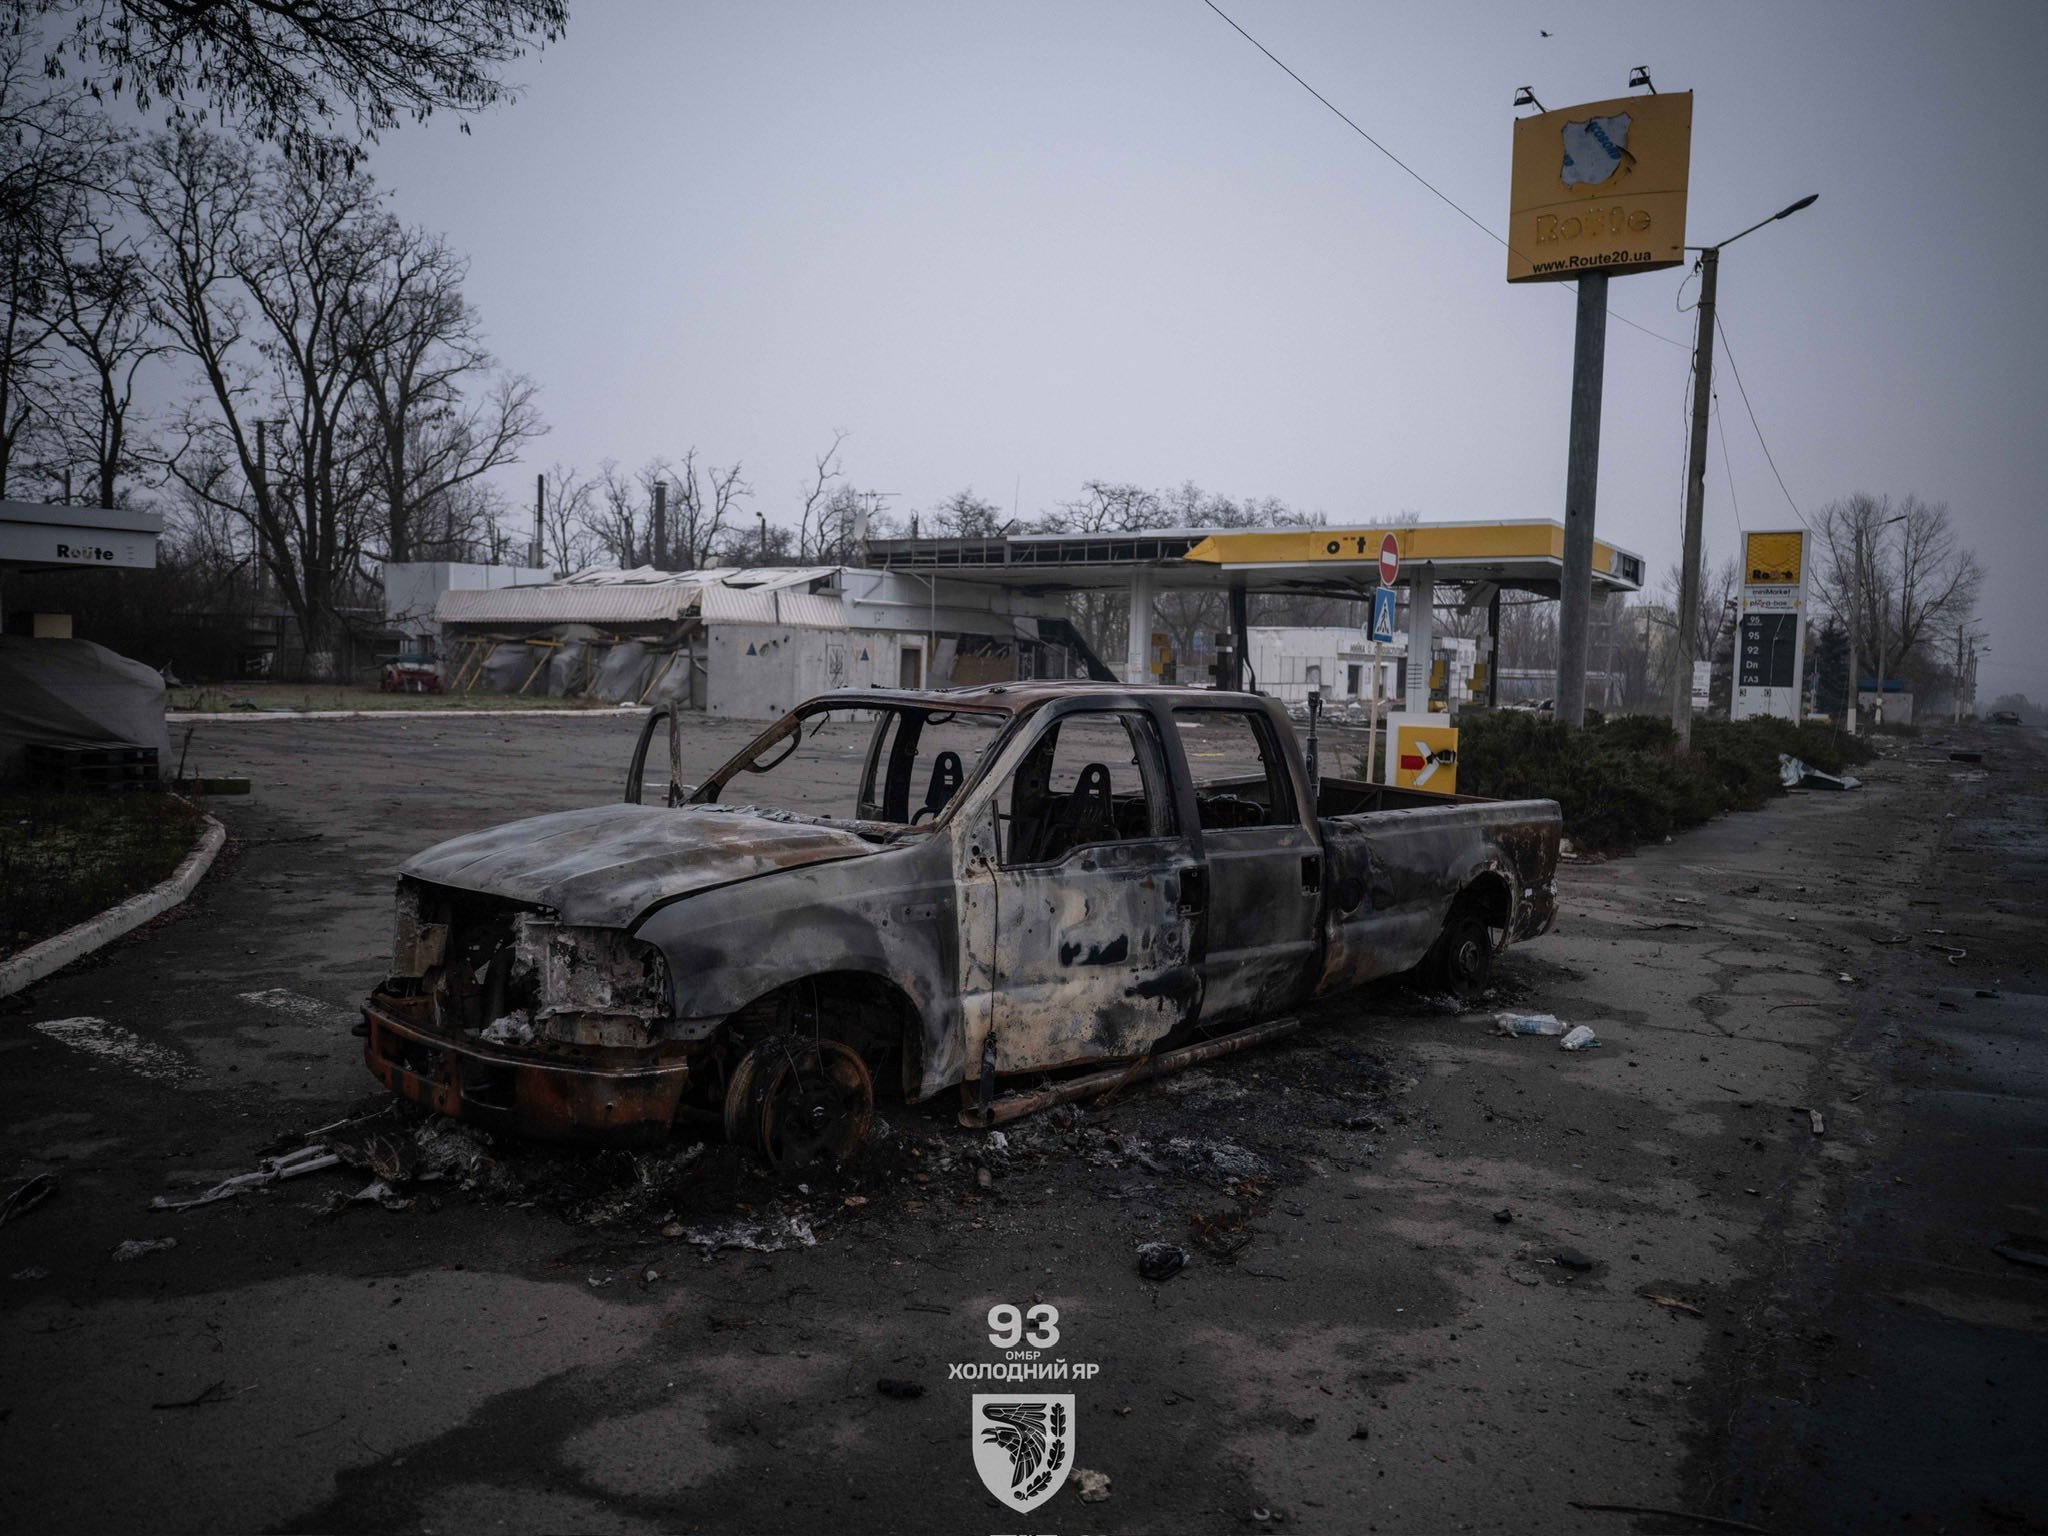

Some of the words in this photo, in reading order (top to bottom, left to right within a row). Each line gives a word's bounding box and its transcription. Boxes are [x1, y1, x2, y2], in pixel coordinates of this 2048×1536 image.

[1532, 250, 1652, 273] www.Route20.ua
[1748, 631, 1760, 640] 95
[1747, 646, 1759, 655] 92
[1743, 675, 1759, 683] ГАЗ
